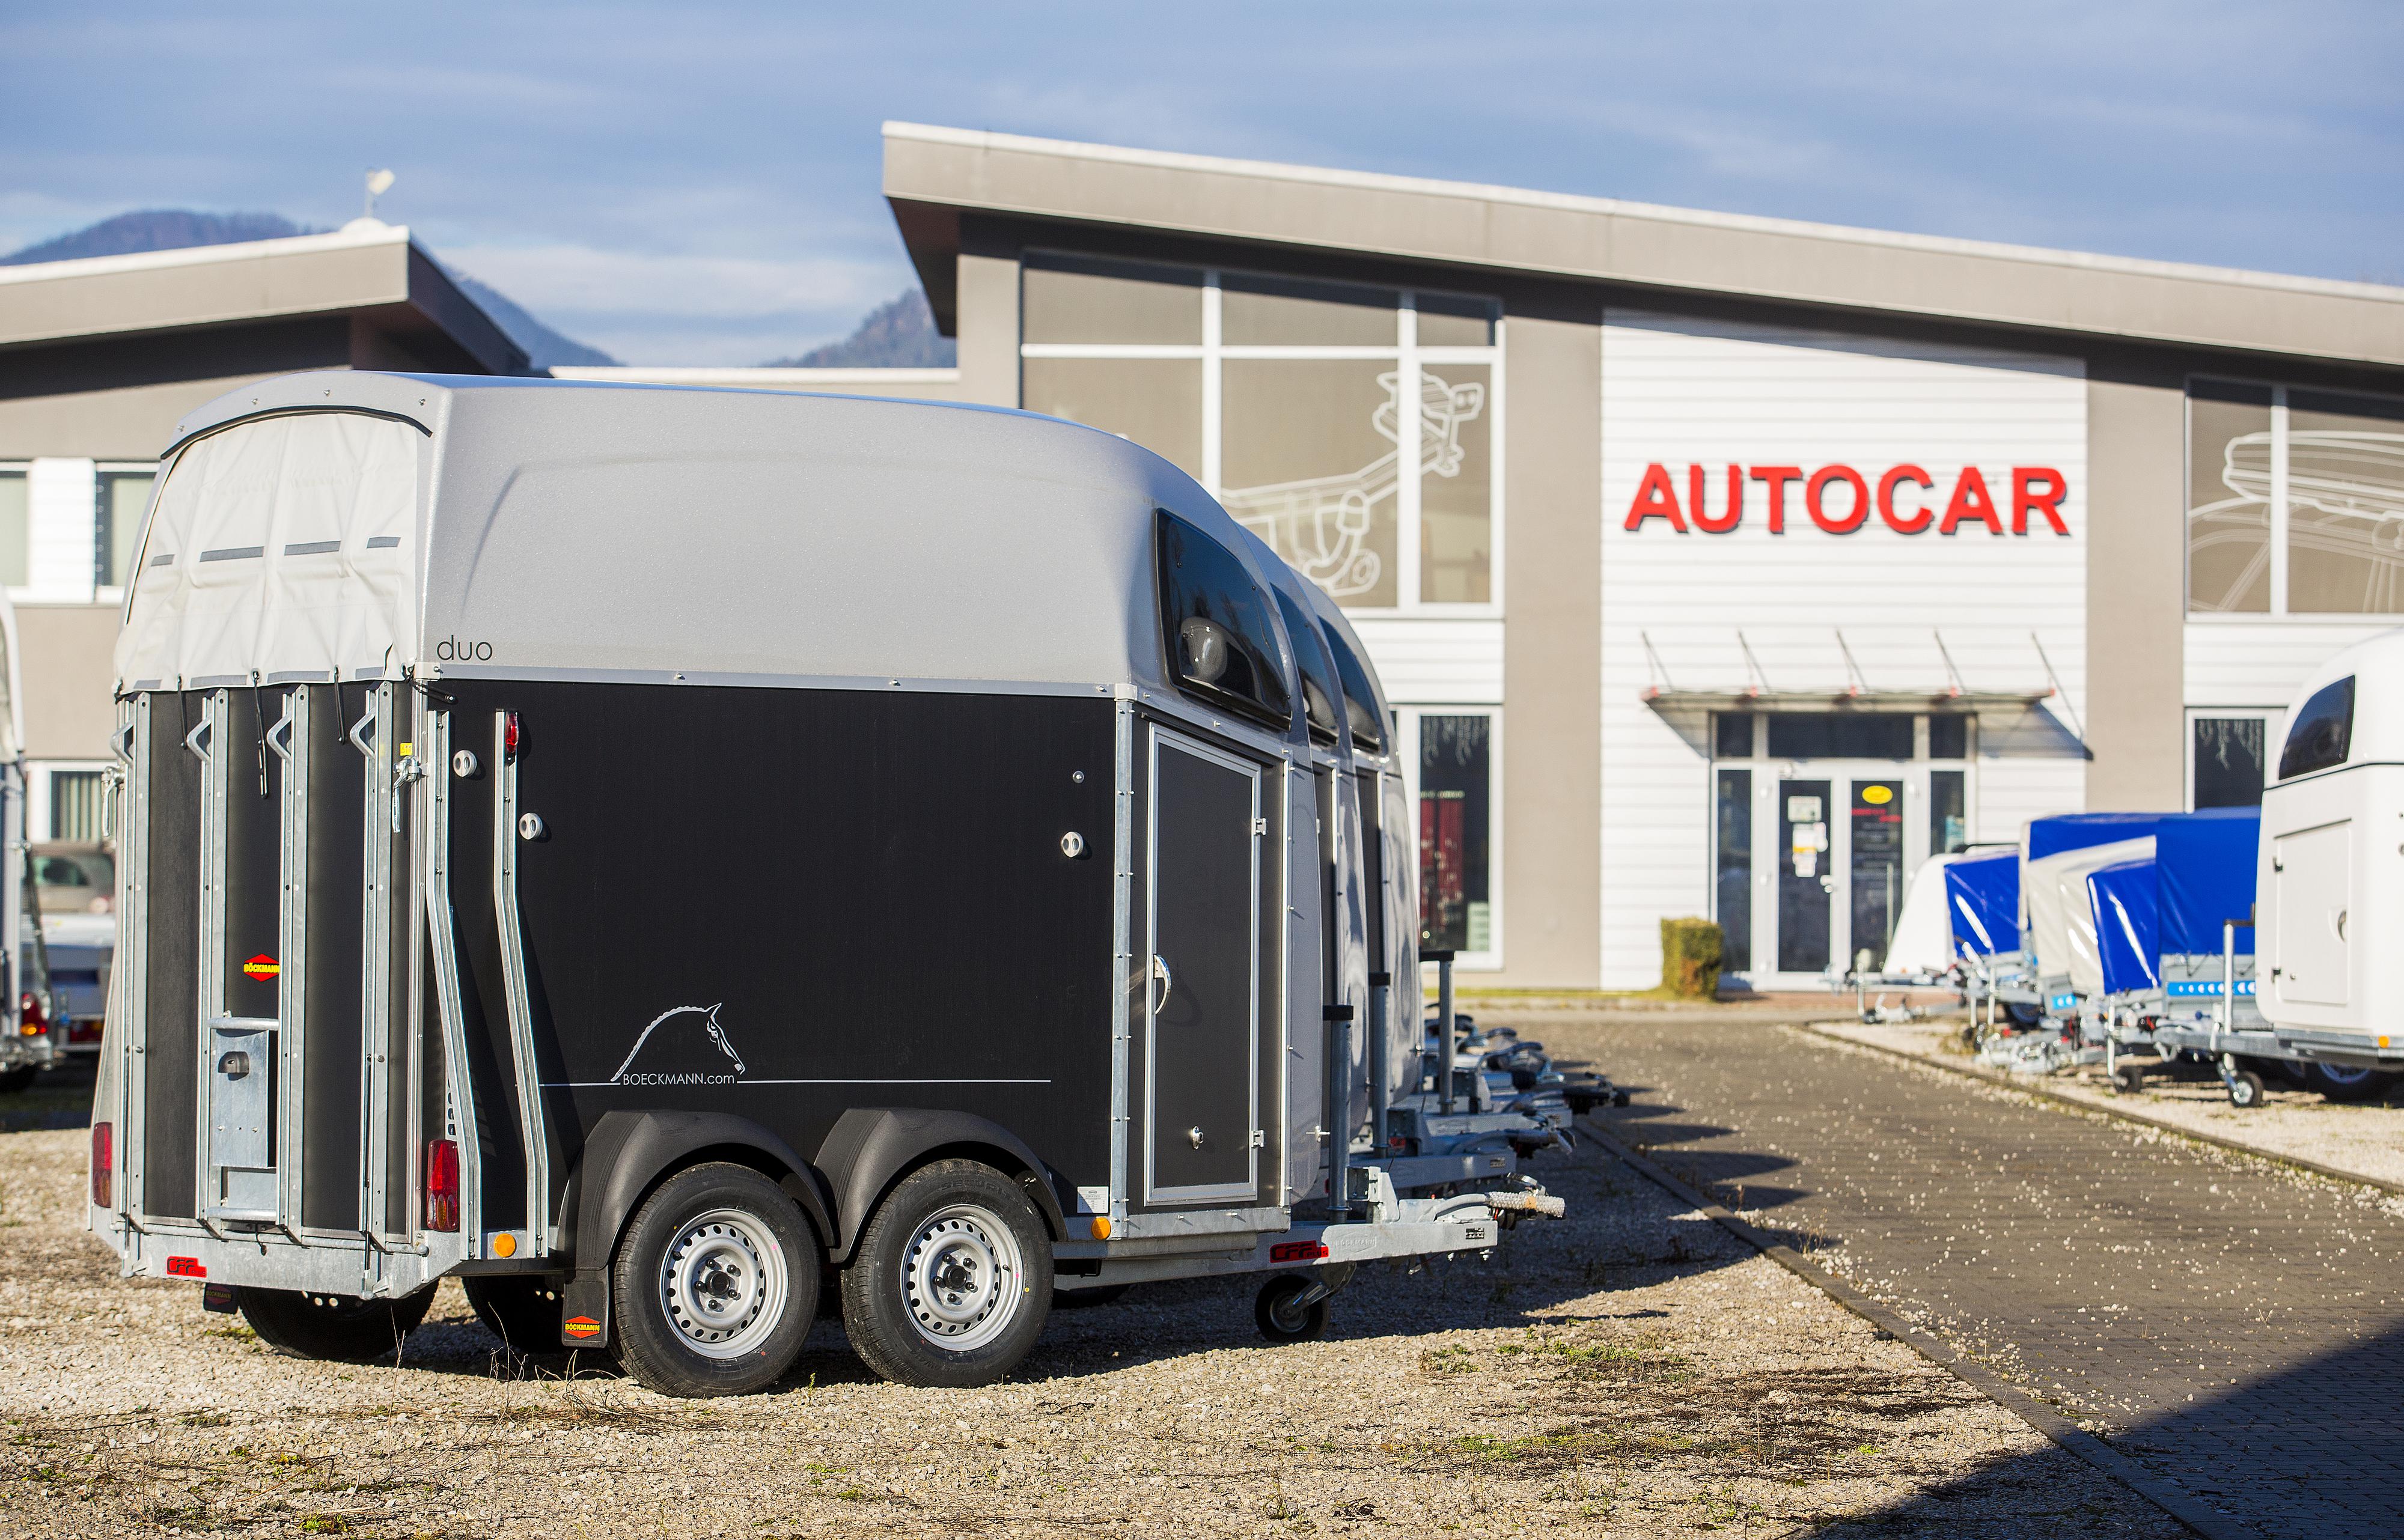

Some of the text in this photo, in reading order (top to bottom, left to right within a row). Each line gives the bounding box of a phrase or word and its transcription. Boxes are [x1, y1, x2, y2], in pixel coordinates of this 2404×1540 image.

[1625, 463, 2070, 535] AUTOCAR
[437, 635, 492, 661] duo
[244, 963, 280, 973] BÖCKMANN
[623, 1073, 734, 1086] BOECKMANN.com
